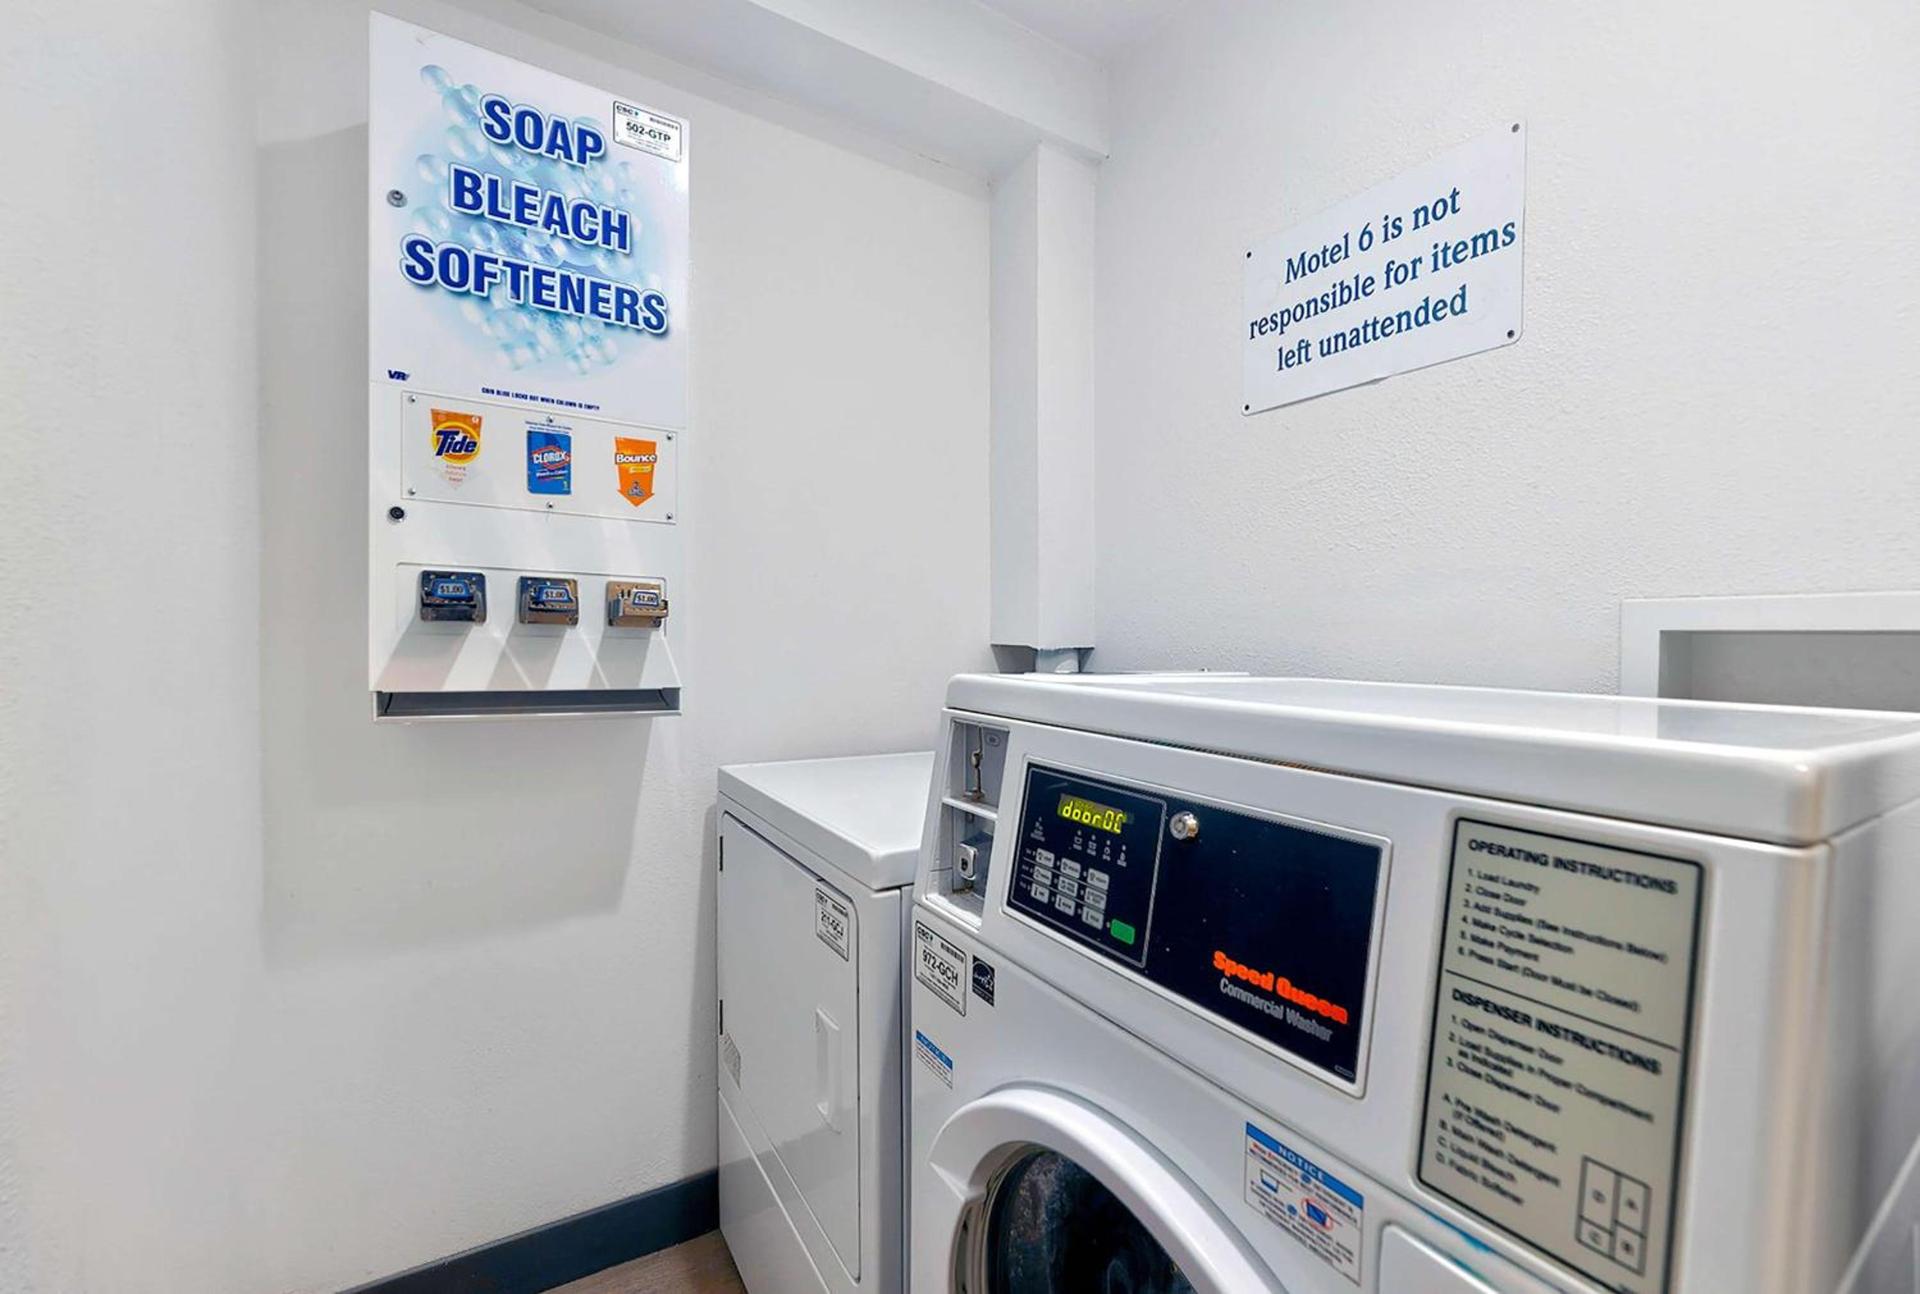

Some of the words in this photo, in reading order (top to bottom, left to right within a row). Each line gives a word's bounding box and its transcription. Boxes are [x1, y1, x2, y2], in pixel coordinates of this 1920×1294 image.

[482, 97, 604, 166] SOAP
[451, 166, 629, 251] BLEACH
[1284, 232, 1351, 285] Motel
[1358, 222, 1373, 252] 6
[1381, 214, 1403, 244] is
[1412, 187, 1461, 231] not
[403, 237, 668, 333] SOFTENERS
[1249, 274, 1376, 340] responsible
[1383, 255, 1422, 290] for
[1431, 221, 1517, 273] items
[1277, 339, 1312, 371] left
[1318, 284, 1468, 358] unattended
[435, 429, 478, 456] Tide
[616, 453, 657, 464] Bounce
[440, 584, 464, 595] $1.00
[544, 590, 566, 601] $1.00
[1468, 839, 1549, 866] OPERATING
[1552, 856, 1678, 895] INSTRUCTIONS
[1213, 950, 1274, 992] Speed
[1276, 977, 1348, 1025] Queen
[1220, 978, 1284, 1020] Commercial
[1286, 1008, 1333, 1042] Washer
[1452, 988, 1532, 1027] DISPENSER
[1536, 1018, 1661, 1075] INSTRUCTIONS
[1278, 1145, 1325, 1181] NOTICE
